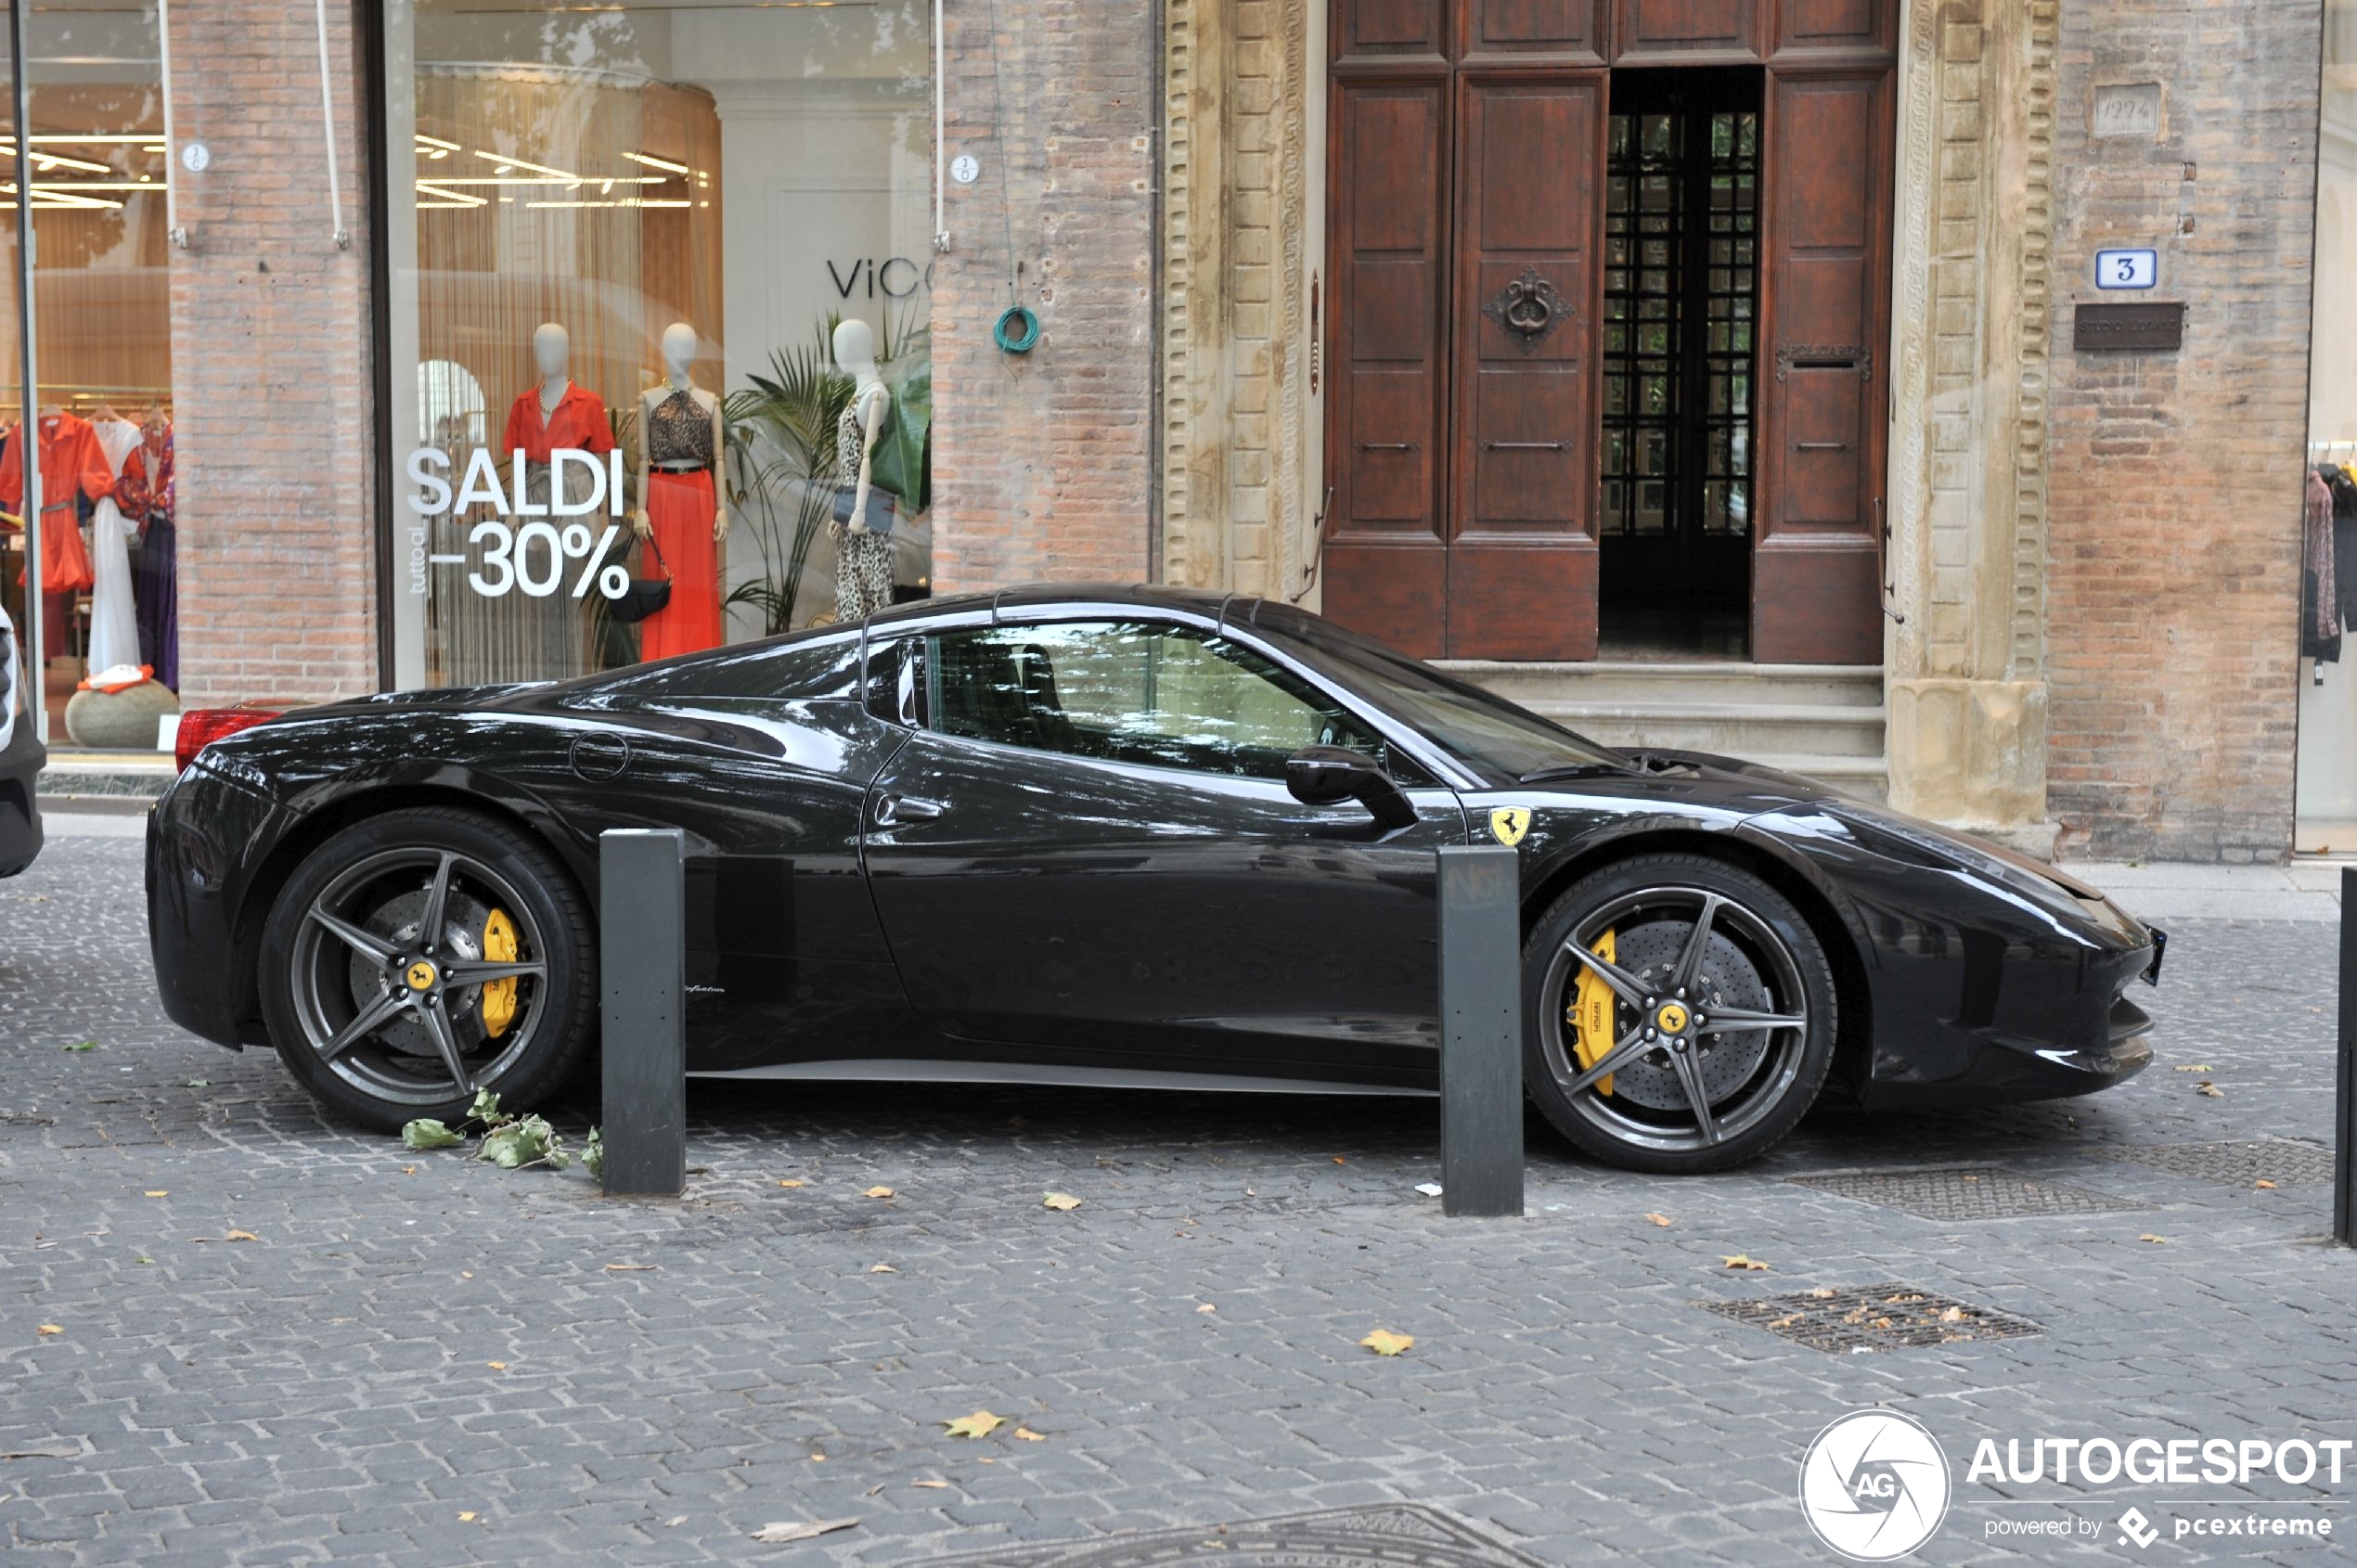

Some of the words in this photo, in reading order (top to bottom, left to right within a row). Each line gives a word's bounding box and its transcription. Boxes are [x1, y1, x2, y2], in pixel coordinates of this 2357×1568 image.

[826, 257, 932, 299] ViC
[2117, 258, 2135, 281] 3
[406, 447, 624, 517] SALDI
[409, 548, 427, 595] tutto
